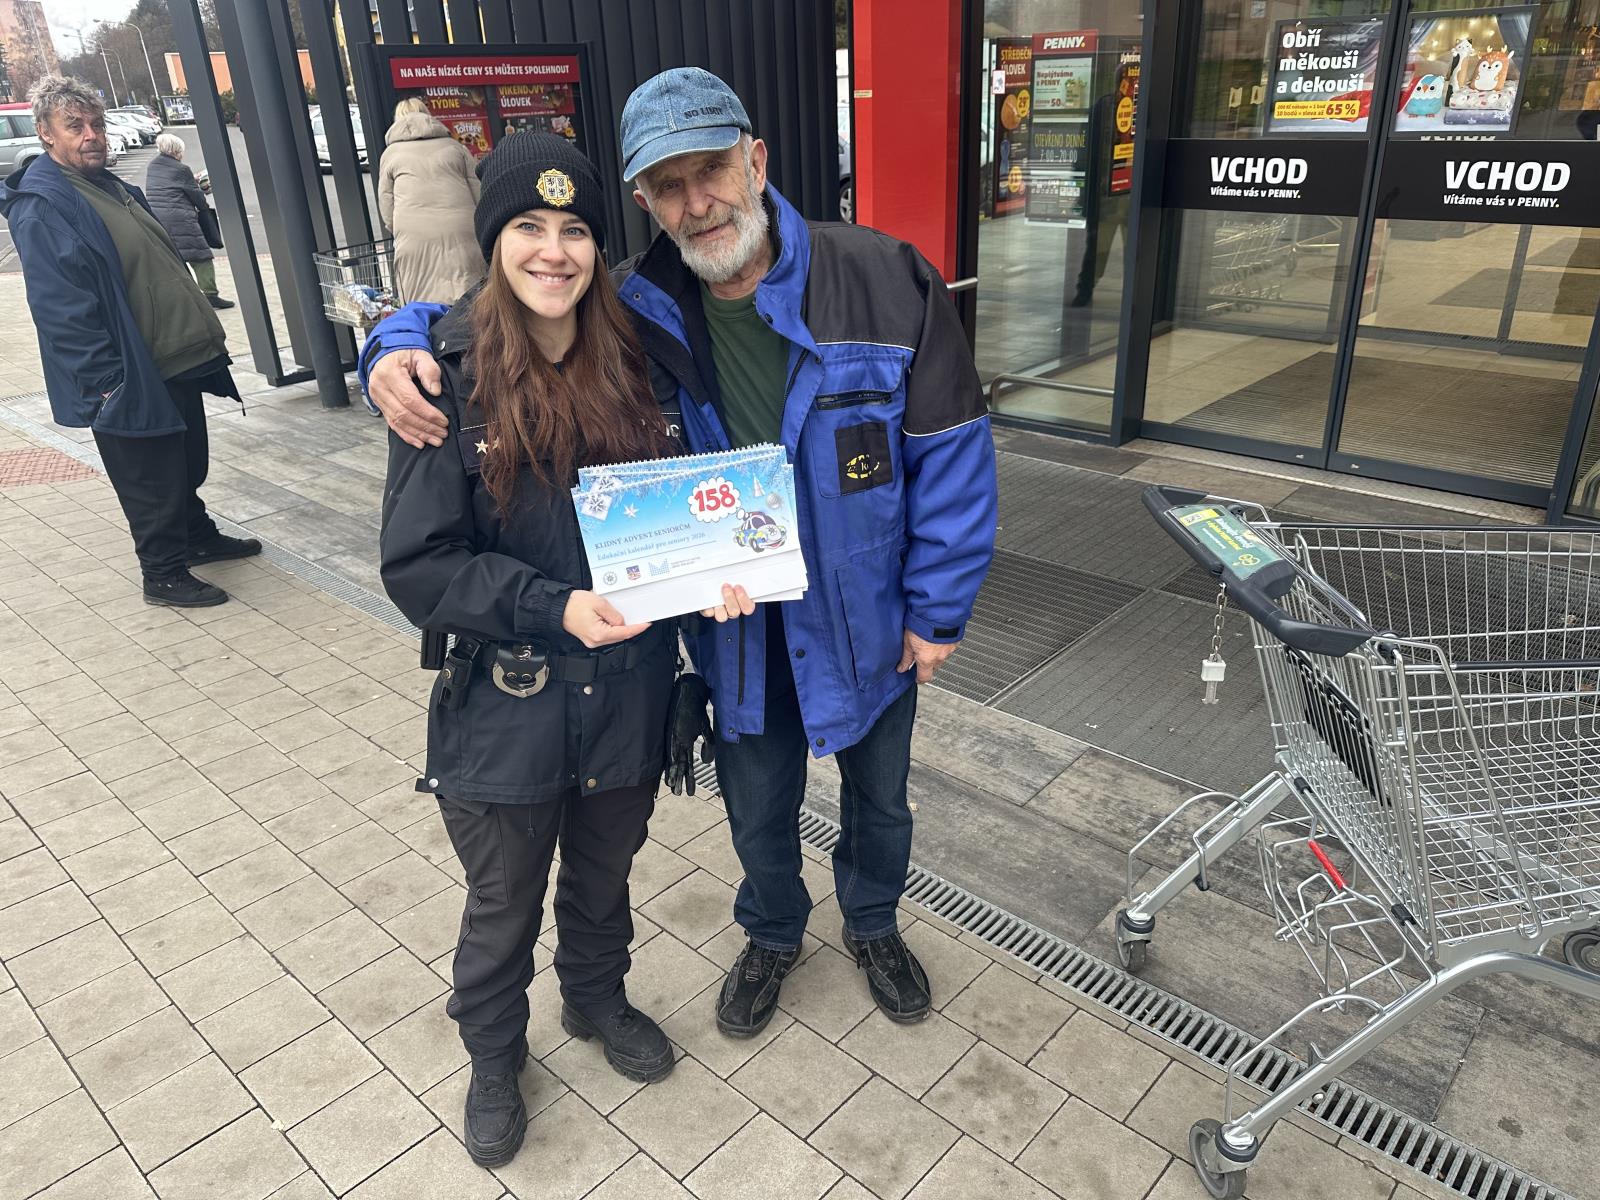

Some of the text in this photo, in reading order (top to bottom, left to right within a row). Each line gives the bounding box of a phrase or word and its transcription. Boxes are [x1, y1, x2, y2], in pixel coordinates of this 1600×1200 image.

[1043, 36, 1086, 50] PENNY.
[1282, 28, 1322, 48] Obří
[1001, 46, 1032, 60] STŘEDEČN
[1280, 50, 1359, 71] měkouši
[400, 63, 570, 78] NA NAŠE NÍZKÉ CENY SE MŮŽETE SPOLEHNOUT
[1276, 73, 1365, 93] a dekouši
[430, 96, 460, 109] TÝDNE
[500, 96, 532, 108] ÚLOVEK
[1326, 104, 1356, 115] 65 %
[684, 109, 699, 119] NO
[1034, 130, 1063, 148] OTEVŘENO
[1210, 157, 1308, 184] VCHOD
[1445, 161, 1571, 191] VCHOD
[1210, 186, 1242, 196] Vítáme
[1243, 187, 1260, 197] vás
[1268, 188, 1301, 198] PENNY.
[1443, 193, 1560, 208] Vítáme vás v PENNY.
[694, 484, 736, 512] 158
[594, 522, 691, 550] KLIDNÝ ADVENT SENIORŮM
[627, 542, 655, 555] kalendář
[667, 536, 690, 546] seniory
